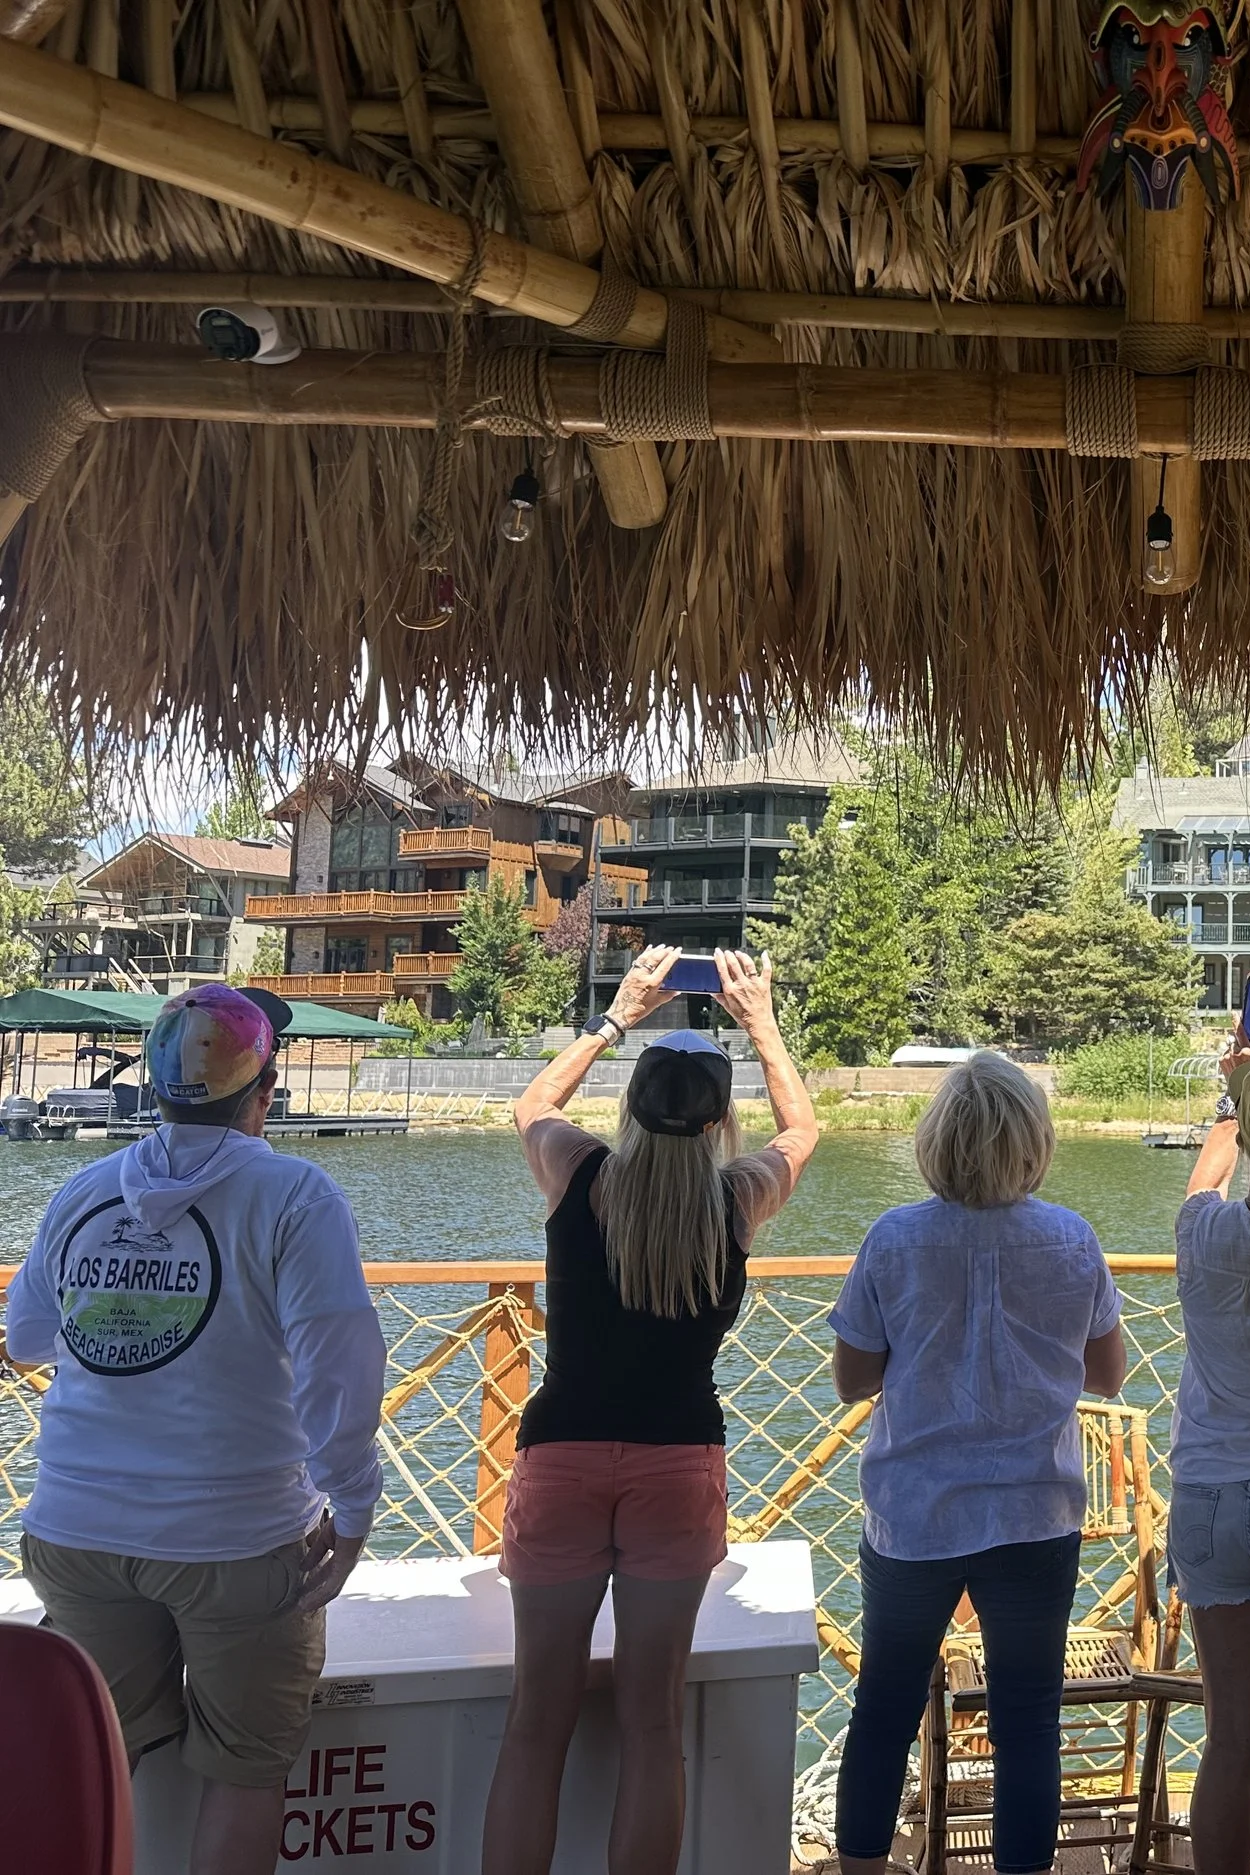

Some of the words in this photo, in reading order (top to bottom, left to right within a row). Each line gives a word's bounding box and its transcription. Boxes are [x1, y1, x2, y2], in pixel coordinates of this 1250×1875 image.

[69, 1256, 102, 1289] LOS
[104, 1257, 201, 1293] BARRILES
[94, 1317, 151, 1327] CALIFORNIA
[109, 1308, 137, 1317] BAJA
[65, 1315, 105, 1363] BEACH
[107, 1320, 185, 1365] PARADISE
[97, 1328, 118, 1337] SUR,
[121, 1329, 144, 1337] MEX
[279, 1800, 436, 1861] CKETS
